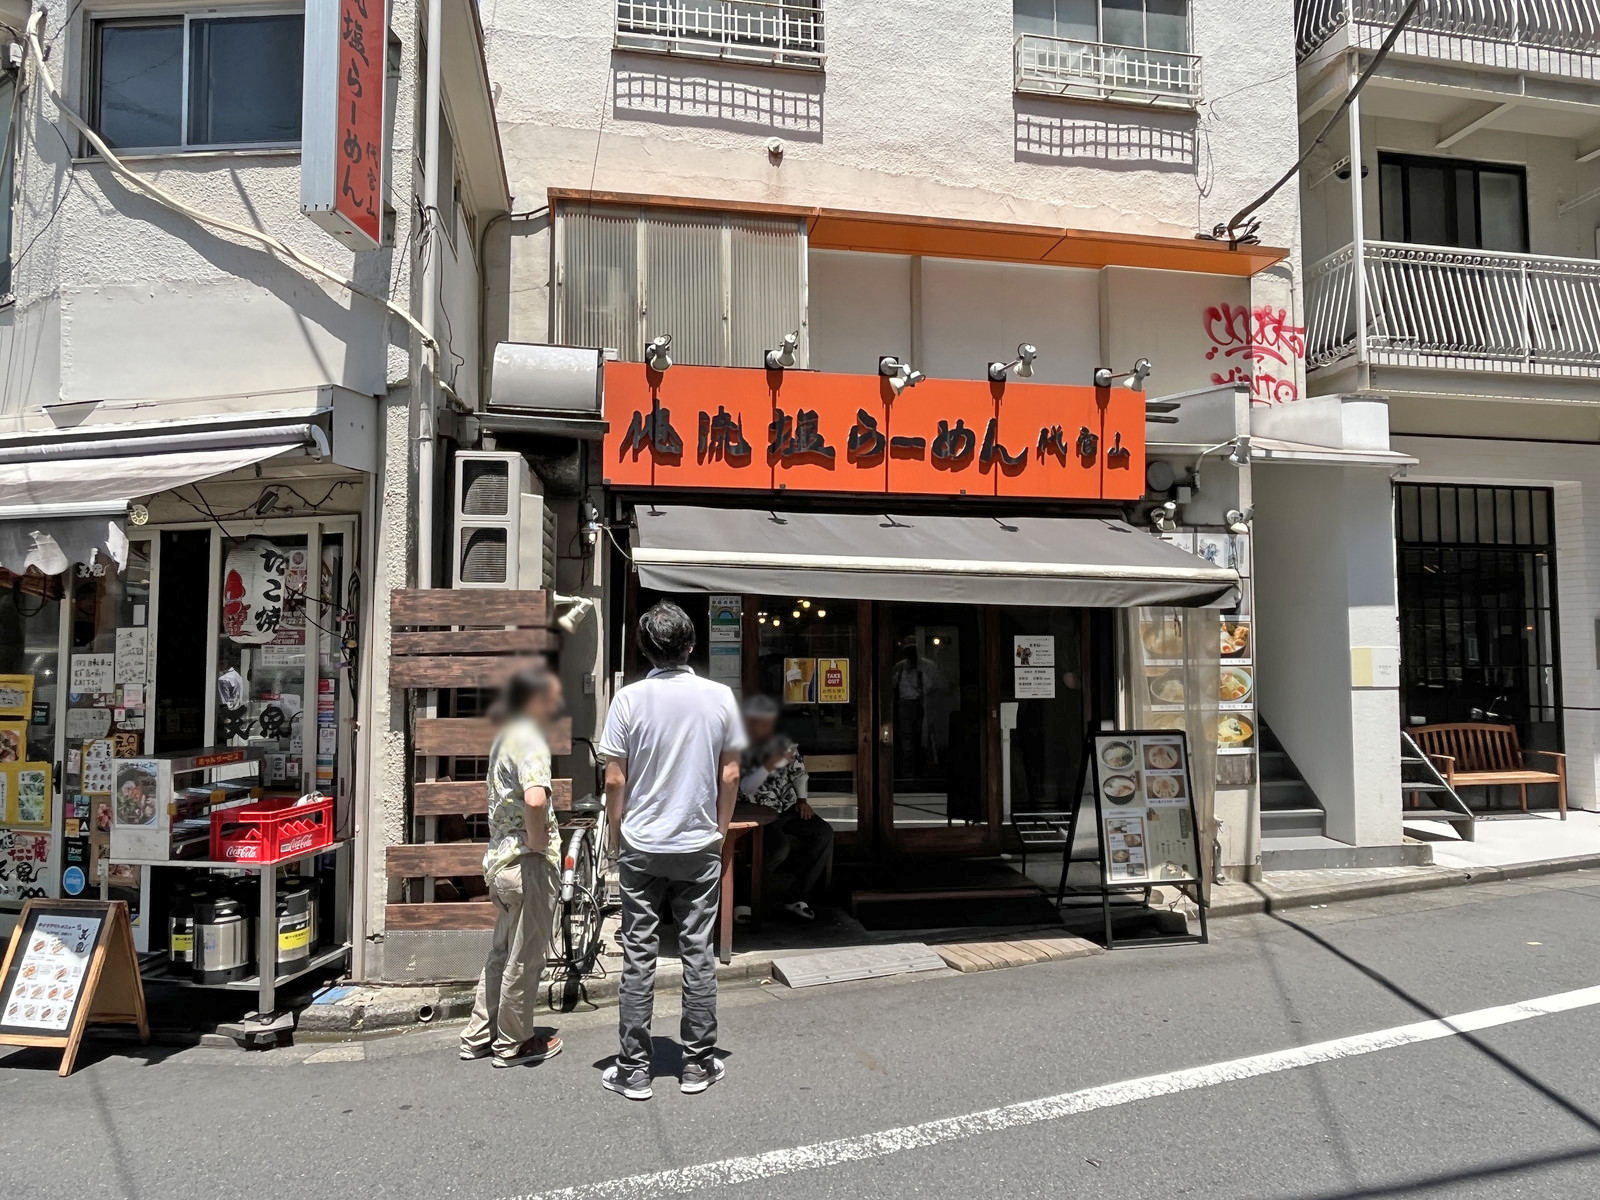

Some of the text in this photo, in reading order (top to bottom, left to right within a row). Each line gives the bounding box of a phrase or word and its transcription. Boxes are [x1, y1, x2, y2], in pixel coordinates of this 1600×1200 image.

[342, 0, 368, 208] 塩らーめん
